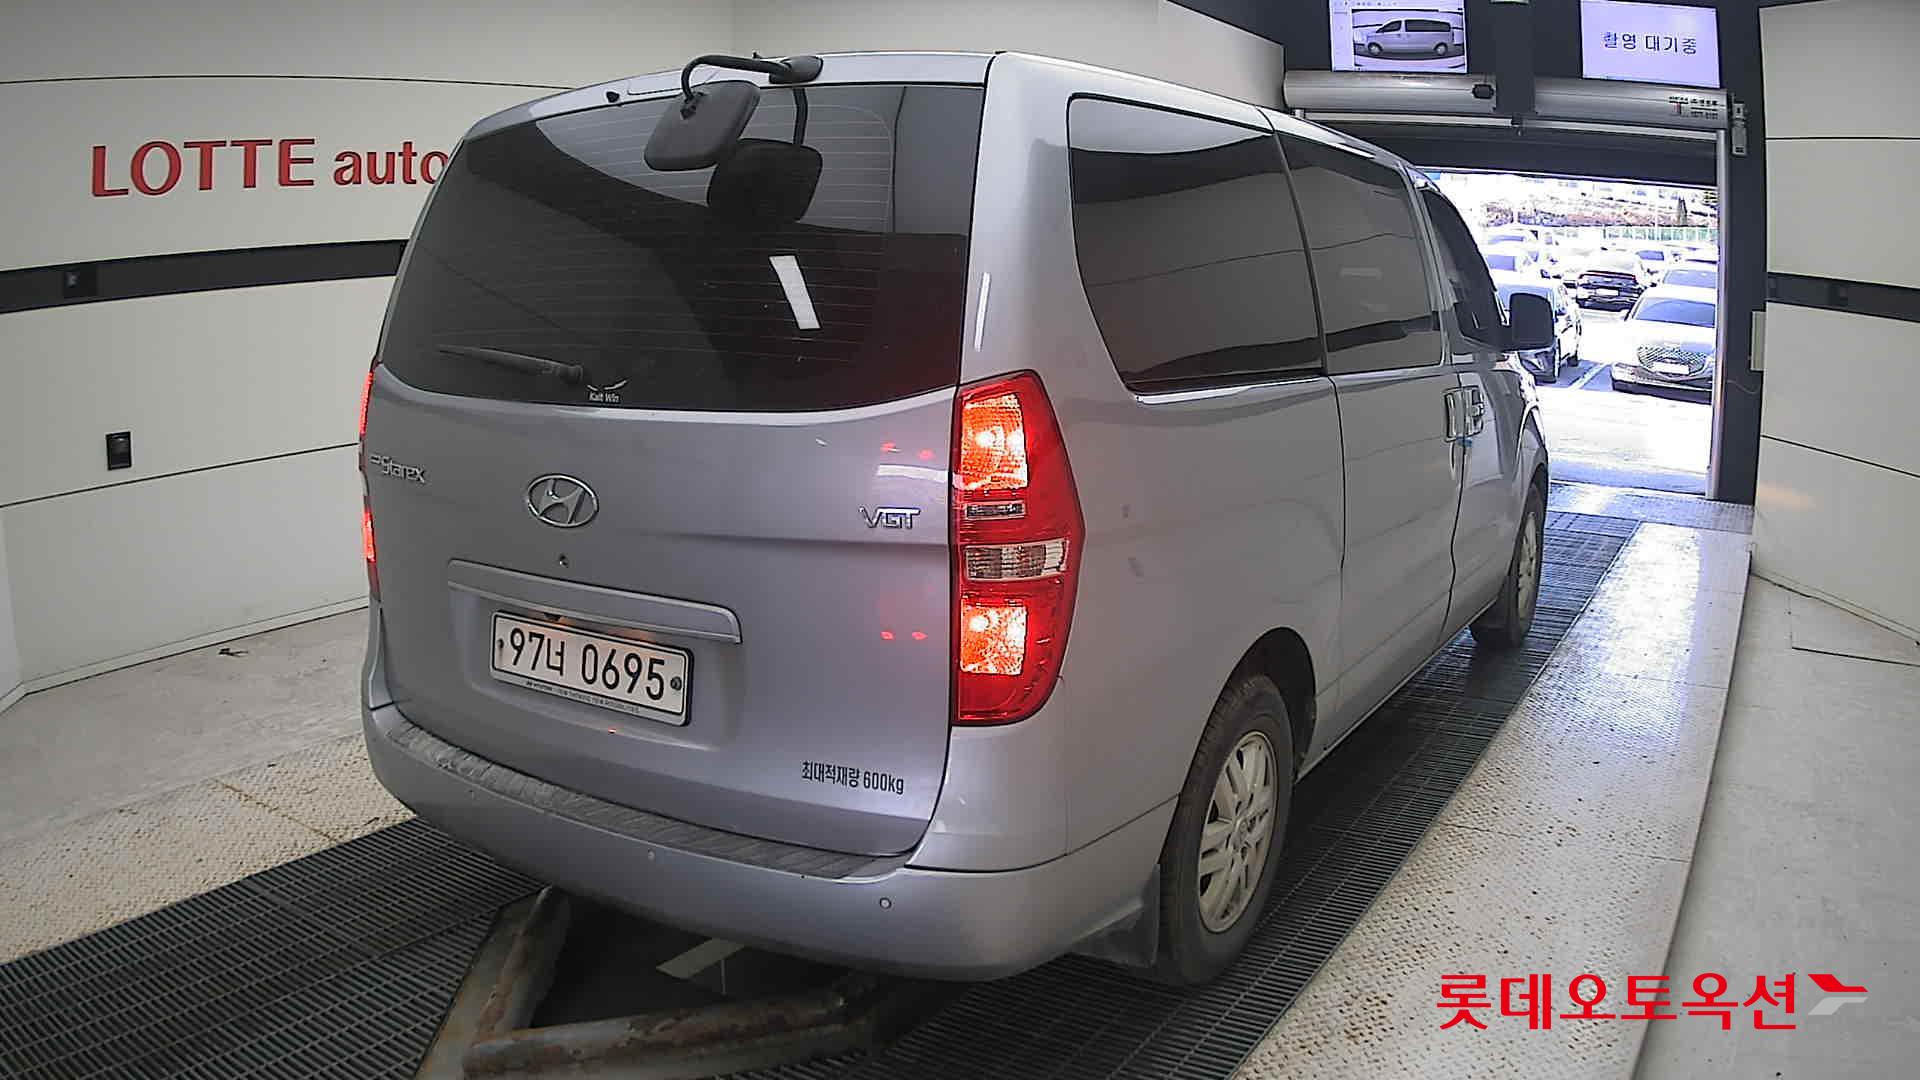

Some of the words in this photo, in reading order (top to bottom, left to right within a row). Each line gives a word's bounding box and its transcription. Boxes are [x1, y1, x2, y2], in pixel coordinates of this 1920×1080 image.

[1602, 31, 1637, 50] 촬영
[1645, 34, 1697, 55] 대기중
[91, 138, 315, 197] LOTTE
[332, 141, 449, 186] auto
[859, 506, 921, 529] VGT
[510, 627, 565, 677] 97너
[581, 643, 665, 701] 0695
[801, 760, 860, 788] 최대적재량
[863, 771, 904, 795] 600kg
